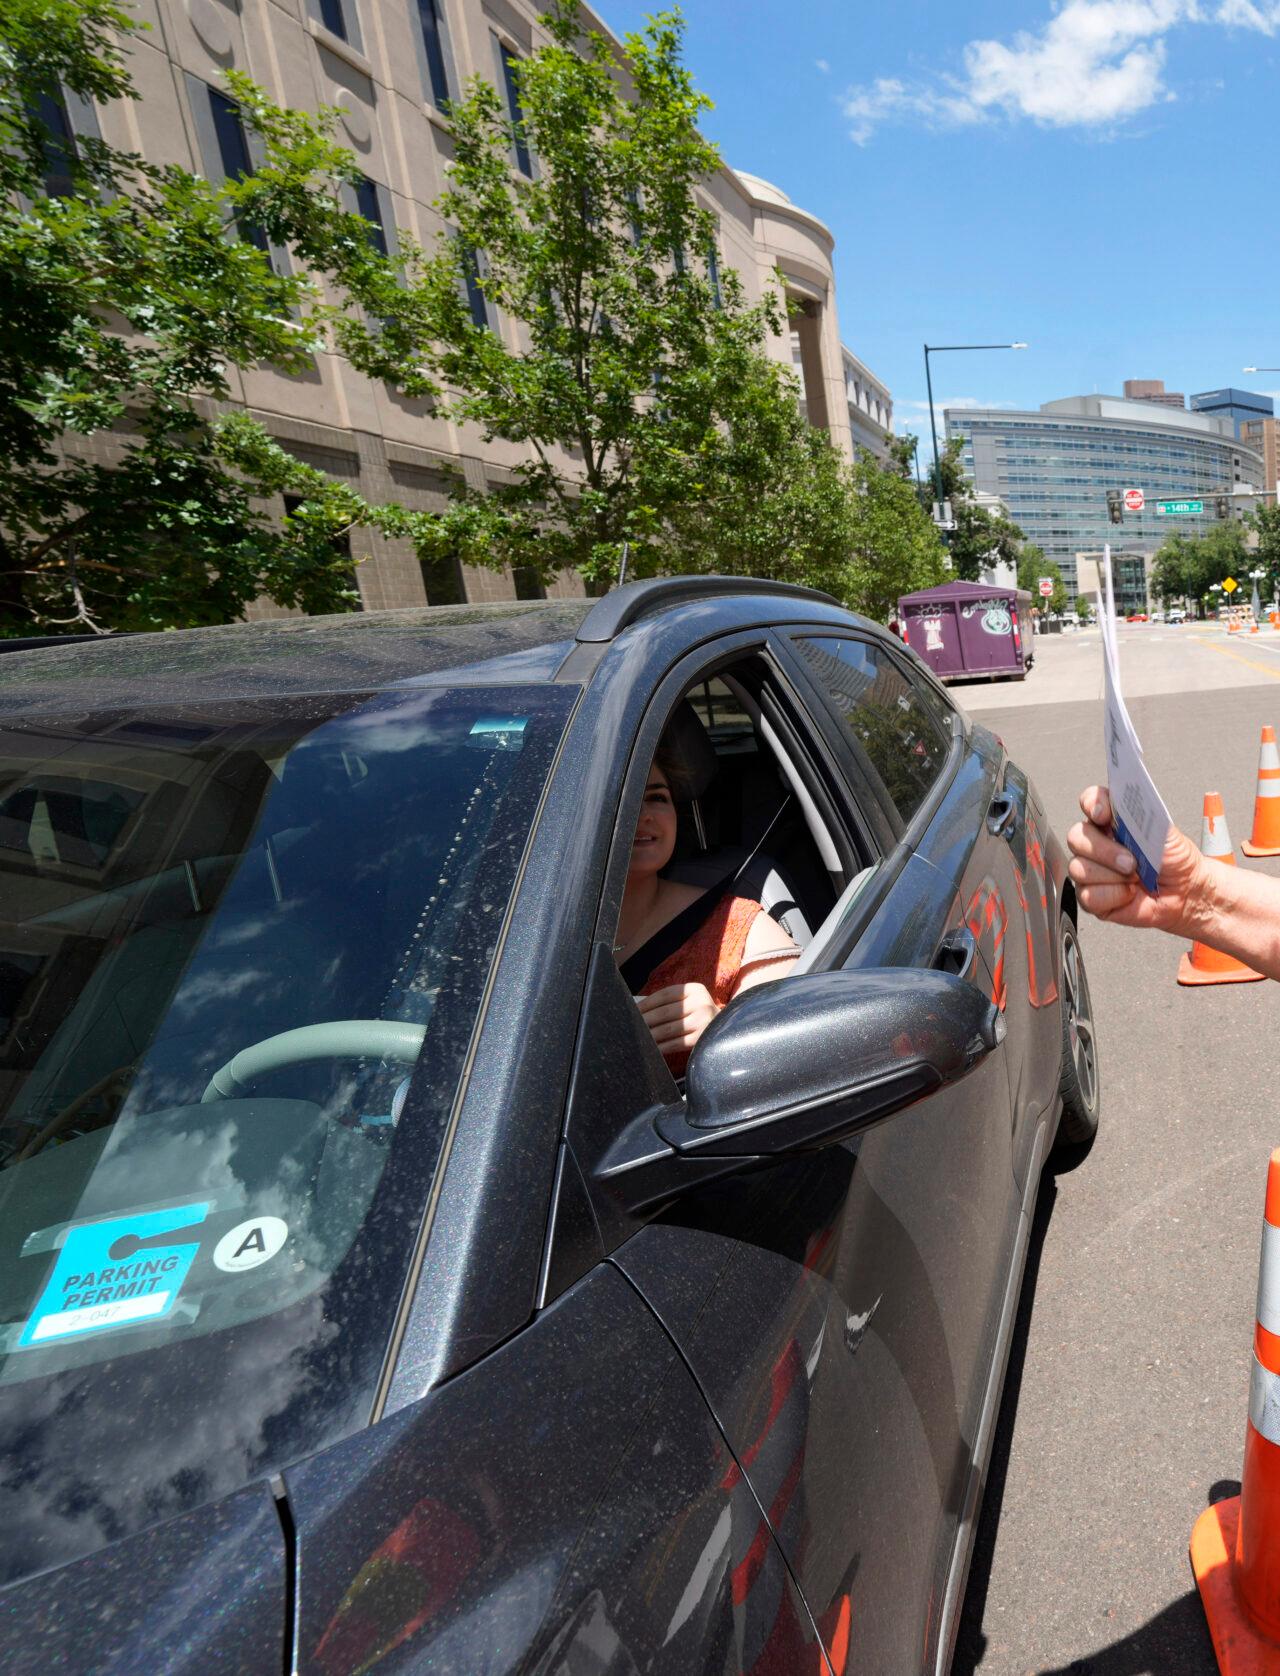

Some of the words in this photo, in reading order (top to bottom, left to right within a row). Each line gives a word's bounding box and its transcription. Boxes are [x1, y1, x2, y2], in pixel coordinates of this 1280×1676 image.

[1171, 503, 1189, 513] 14th
[232, 1227, 266, 1258] A
[62, 1256, 179, 1293] PARKING
[61, 1276, 163, 1310] PERMIT
